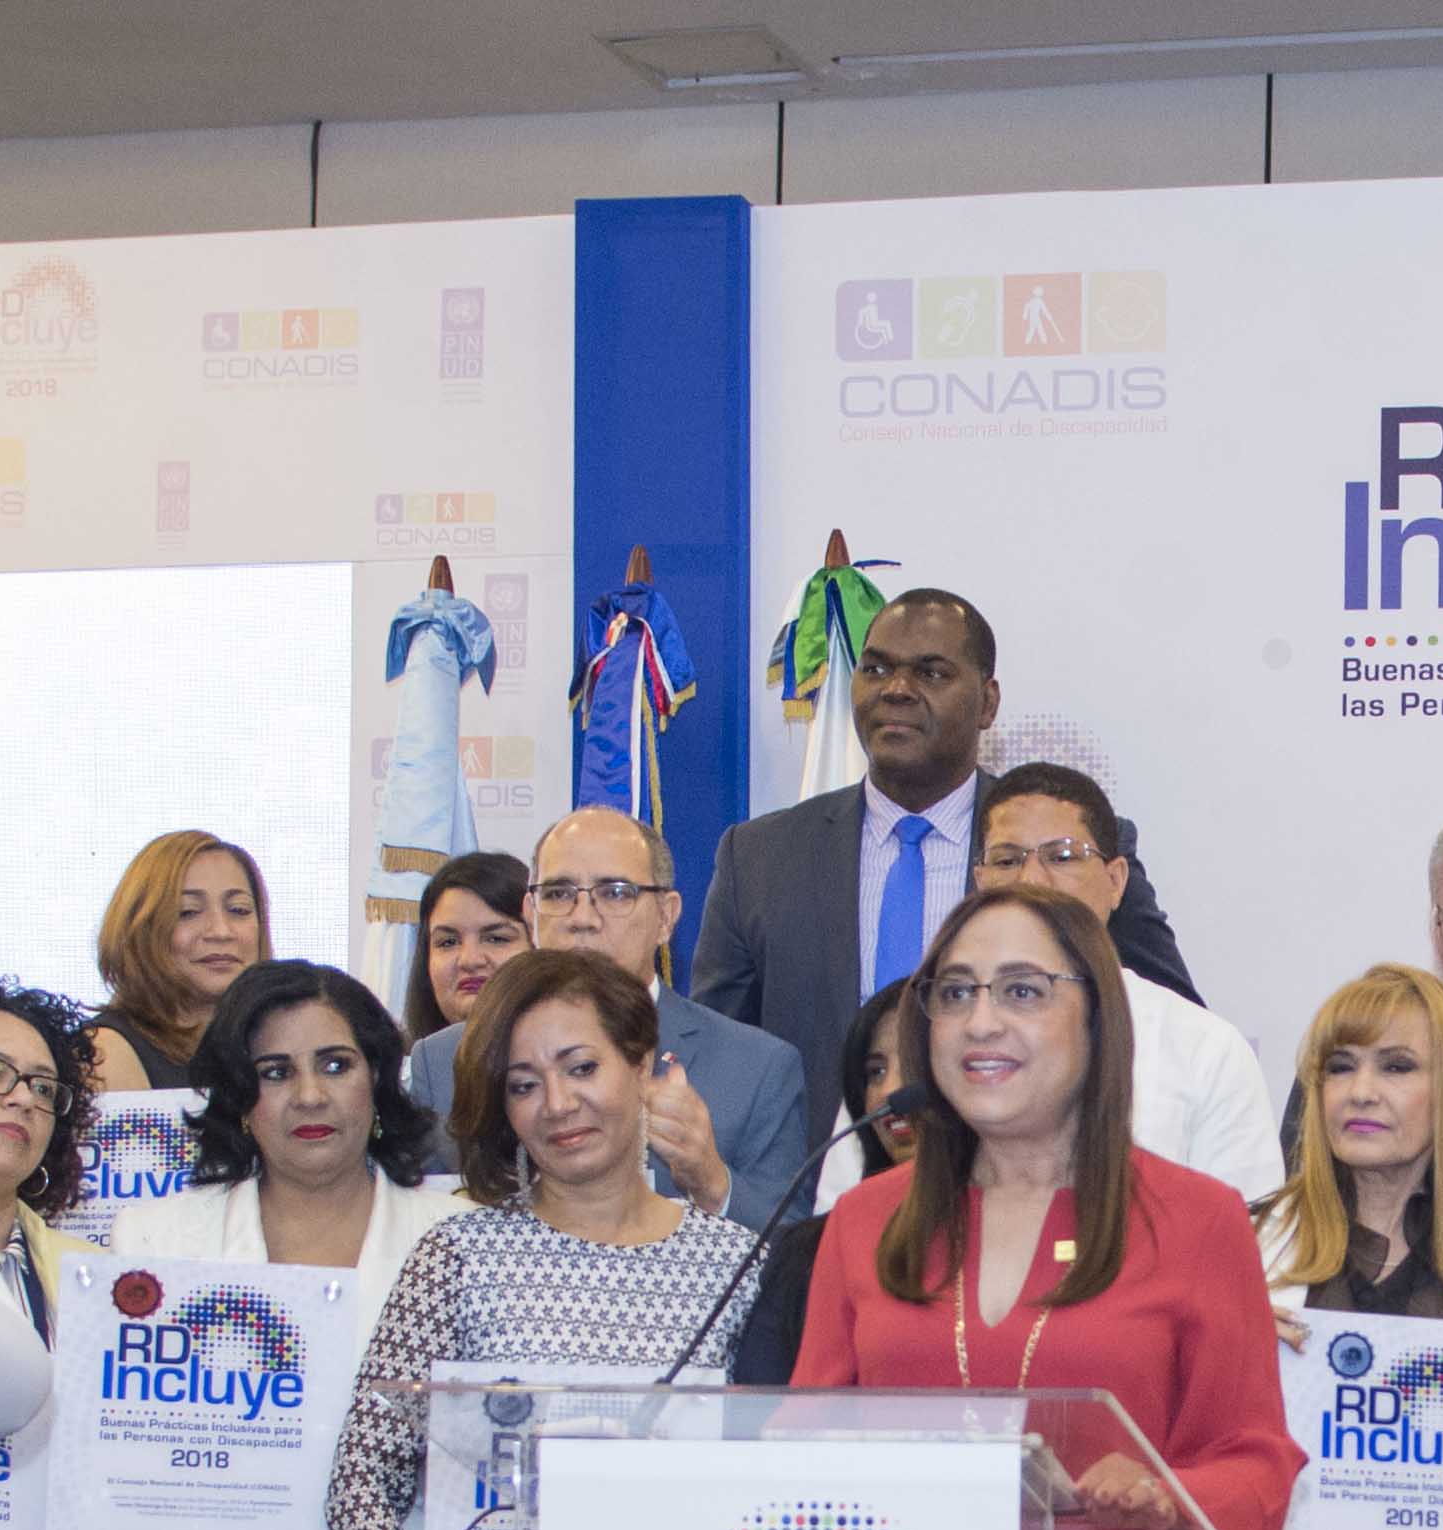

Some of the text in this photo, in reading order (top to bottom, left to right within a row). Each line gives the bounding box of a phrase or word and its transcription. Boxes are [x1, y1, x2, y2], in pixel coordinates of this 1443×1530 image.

[202, 353, 358, 380] CONADIS
[5, 378, 58, 399] 2018
[839, 366, 1168, 419] CONADIS
[839, 416, 1168, 443] Consejo Nacional de Discapacidad
[376, 528, 496, 545] CONADIS
[1342, 693, 1385, 717] las
[117, 1323, 191, 1367] RD
[101, 1350, 304, 1421] Incluye
[1335, 1384, 1401, 1427] RD
[99, 1417, 146, 1430] Buenas
[211, 1423, 271, 1435] Inclusivas
[274, 1428, 302, 1437] para
[99, 1430, 302, 1450] las Personas con Discapacidad
[171, 1450, 229, 1470] 2018
[1386, 1509, 1439, 1529] 2018
